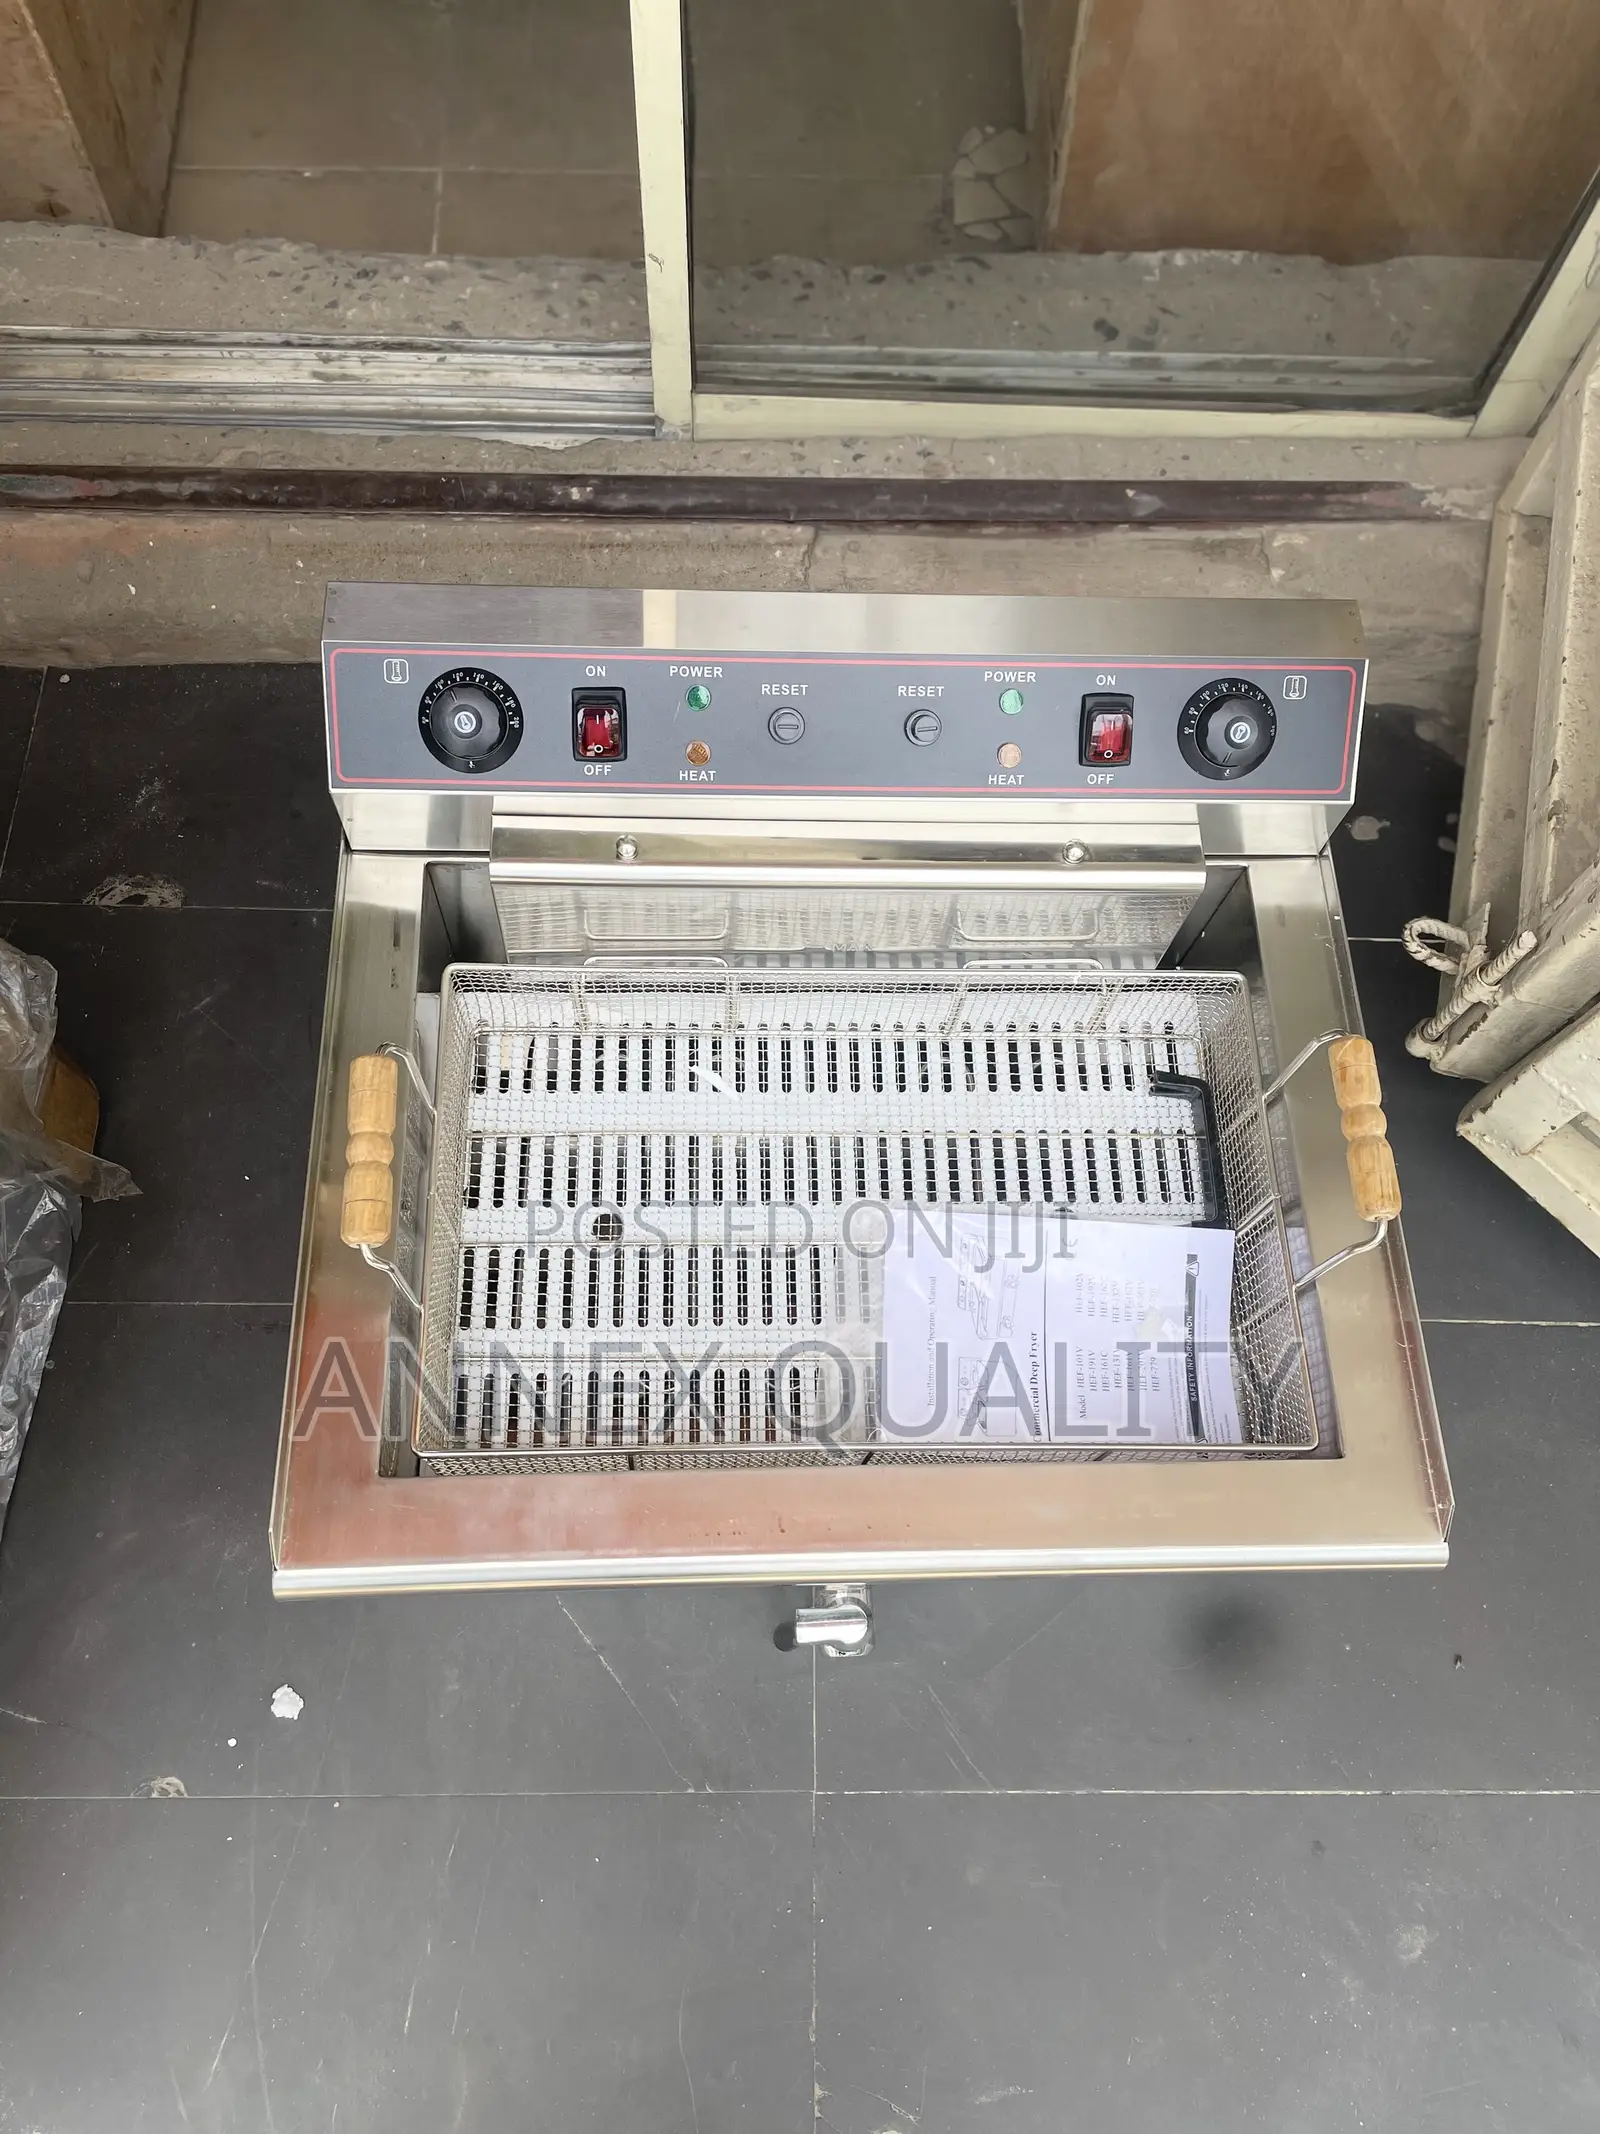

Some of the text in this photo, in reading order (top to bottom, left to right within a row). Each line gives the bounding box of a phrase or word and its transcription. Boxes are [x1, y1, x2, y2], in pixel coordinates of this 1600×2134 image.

[585, 665, 606, 677] ON
[669, 665, 723, 678] POWER
[984, 671, 1036, 683] POWER
[1095, 674, 1116, 686] ON
[761, 684, 809, 696] RESET
[897, 686, 944, 697] RESET
[583, 764, 612, 776] OFF
[679, 770, 716, 781] HEAT
[988, 774, 1025, 785] HEAT
[1086, 773, 1115, 785] OFF
[832, 943, 873, 952] MAX
[928, 1276, 937, 1306] Manual
[1185, 1315, 1196, 1369] INFORMATION
[1076, 1347, 1085, 1388] HEF-101V
[1088, 1350, 1098, 1392] HEF-191V
[1101, 1351, 1111, 1392] HEF-161C
[1150, 1356, 1160, 1392] HEF-779
[927, 1364, 936, 1406] Installation
[1029, 1331, 1042, 1443] Commercial Deep Fryer
[1187, 1371, 1197, 1402] SAFETY
